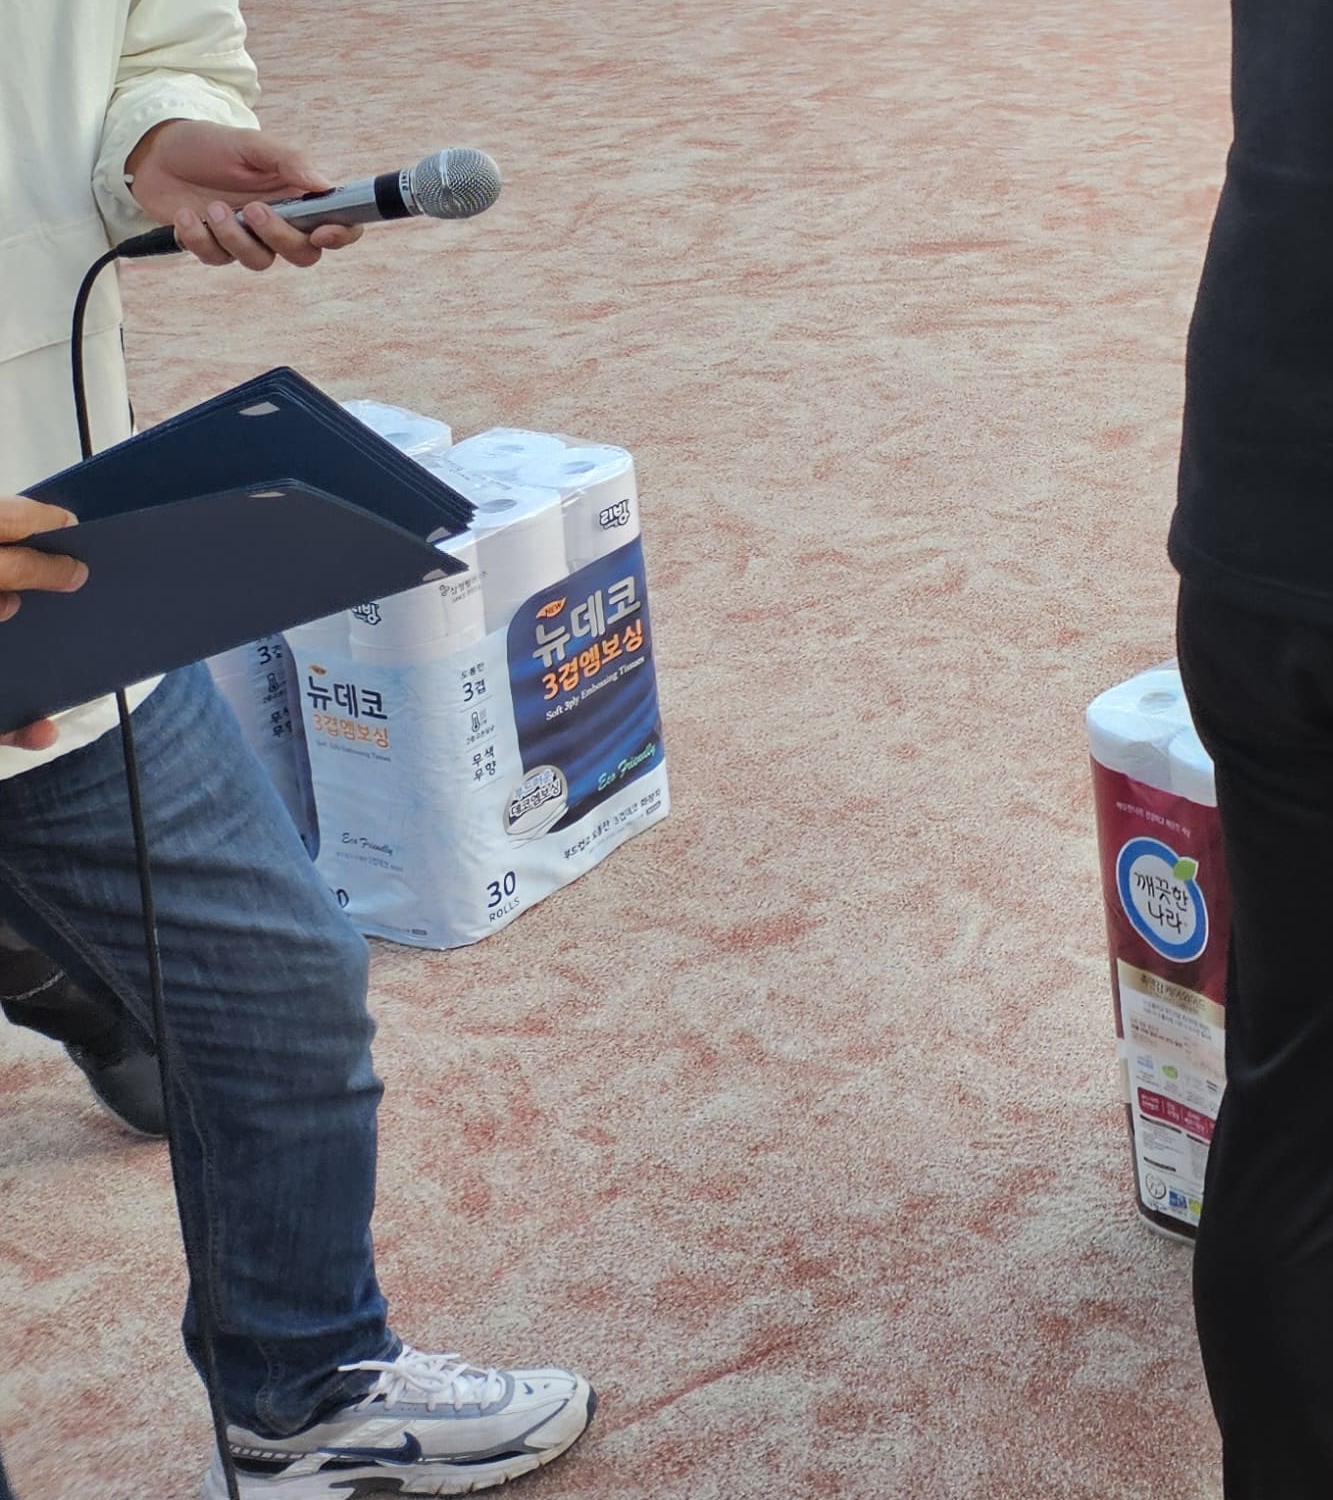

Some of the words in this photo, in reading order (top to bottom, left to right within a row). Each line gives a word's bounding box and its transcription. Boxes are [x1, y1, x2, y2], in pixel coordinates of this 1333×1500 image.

[532, 576, 641, 668] 뉴데코
[542, 619, 643, 700] 3겹엠보싱
[306, 675, 388, 720] 뉴데코
[462, 679, 486, 702] 3겹
[546, 704, 564, 720] Soft
[581, 671, 619, 700] Embossing
[313, 713, 390, 749] 3겹엠보싱
[486, 870, 516, 908] 30
[1134, 871, 1188, 912] 깨끗한
[489, 897, 520, 922] ROLLS
[1148, 900, 1182, 934] 나라
